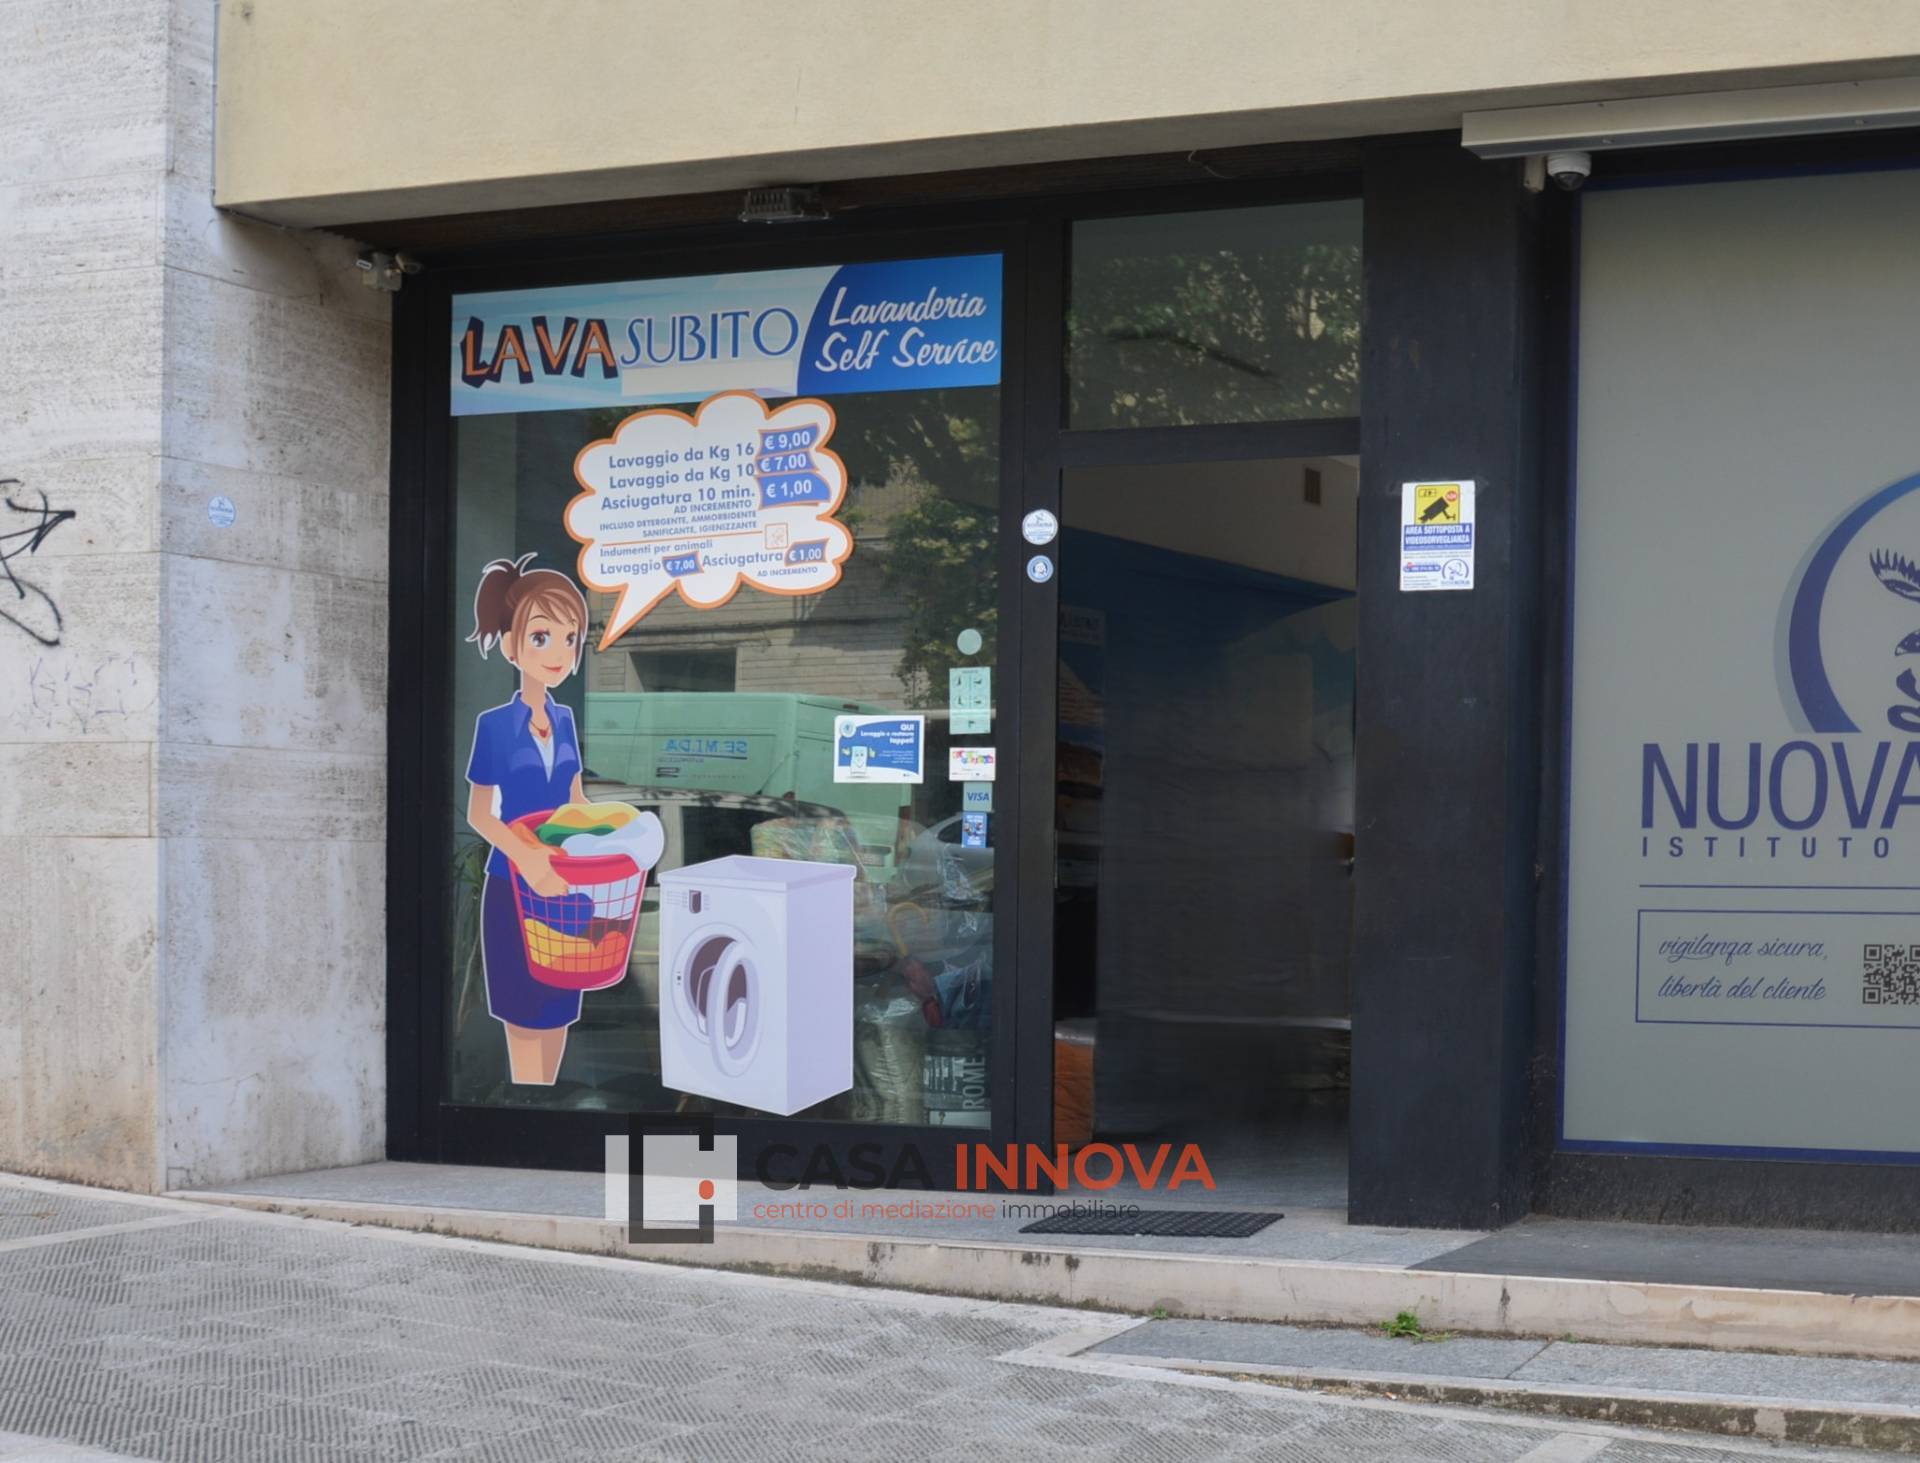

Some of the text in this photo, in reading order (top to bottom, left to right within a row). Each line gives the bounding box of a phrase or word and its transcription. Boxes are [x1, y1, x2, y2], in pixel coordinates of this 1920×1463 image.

[829, 286, 987, 327] Lavanderia
[815, 327, 999, 373] Self Service
[608, 449, 679, 469] Lavaggio
[684, 447, 704, 462] da
[709, 445, 730, 461] Kg
[736, 442, 754, 457] 16
[609, 470, 679, 489] Lavaggio
[684, 468, 704, 482] da
[710, 465, 731, 481] Kg
[736, 463, 755, 477] 10
[601, 494, 692, 510] Asciugatura
[698, 487, 716, 502] 10
[721, 484, 755, 500] min.
[674, 500, 752, 514] AD INCREMENTO
[599, 519, 635, 531] INCLUSO
[691, 510, 757, 523] AMMORBIDENTE
[699, 521, 757, 533] IGIENIZZANTE
[600, 539, 713, 557] Indumenti per animali
[600, 560, 661, 575] Lavaggio
[702, 551, 783, 567] Asciugatura
[770, 566, 818, 576] INCREMENTO
[900, 723, 915, 731] QUI
[966, 792, 990, 801] VISA
[1642, 836, 1889, 858] ISTITUTO
[1757, 938, 1828, 961] sicura,
[1657, 975, 1827, 1000] libertà del cliente
